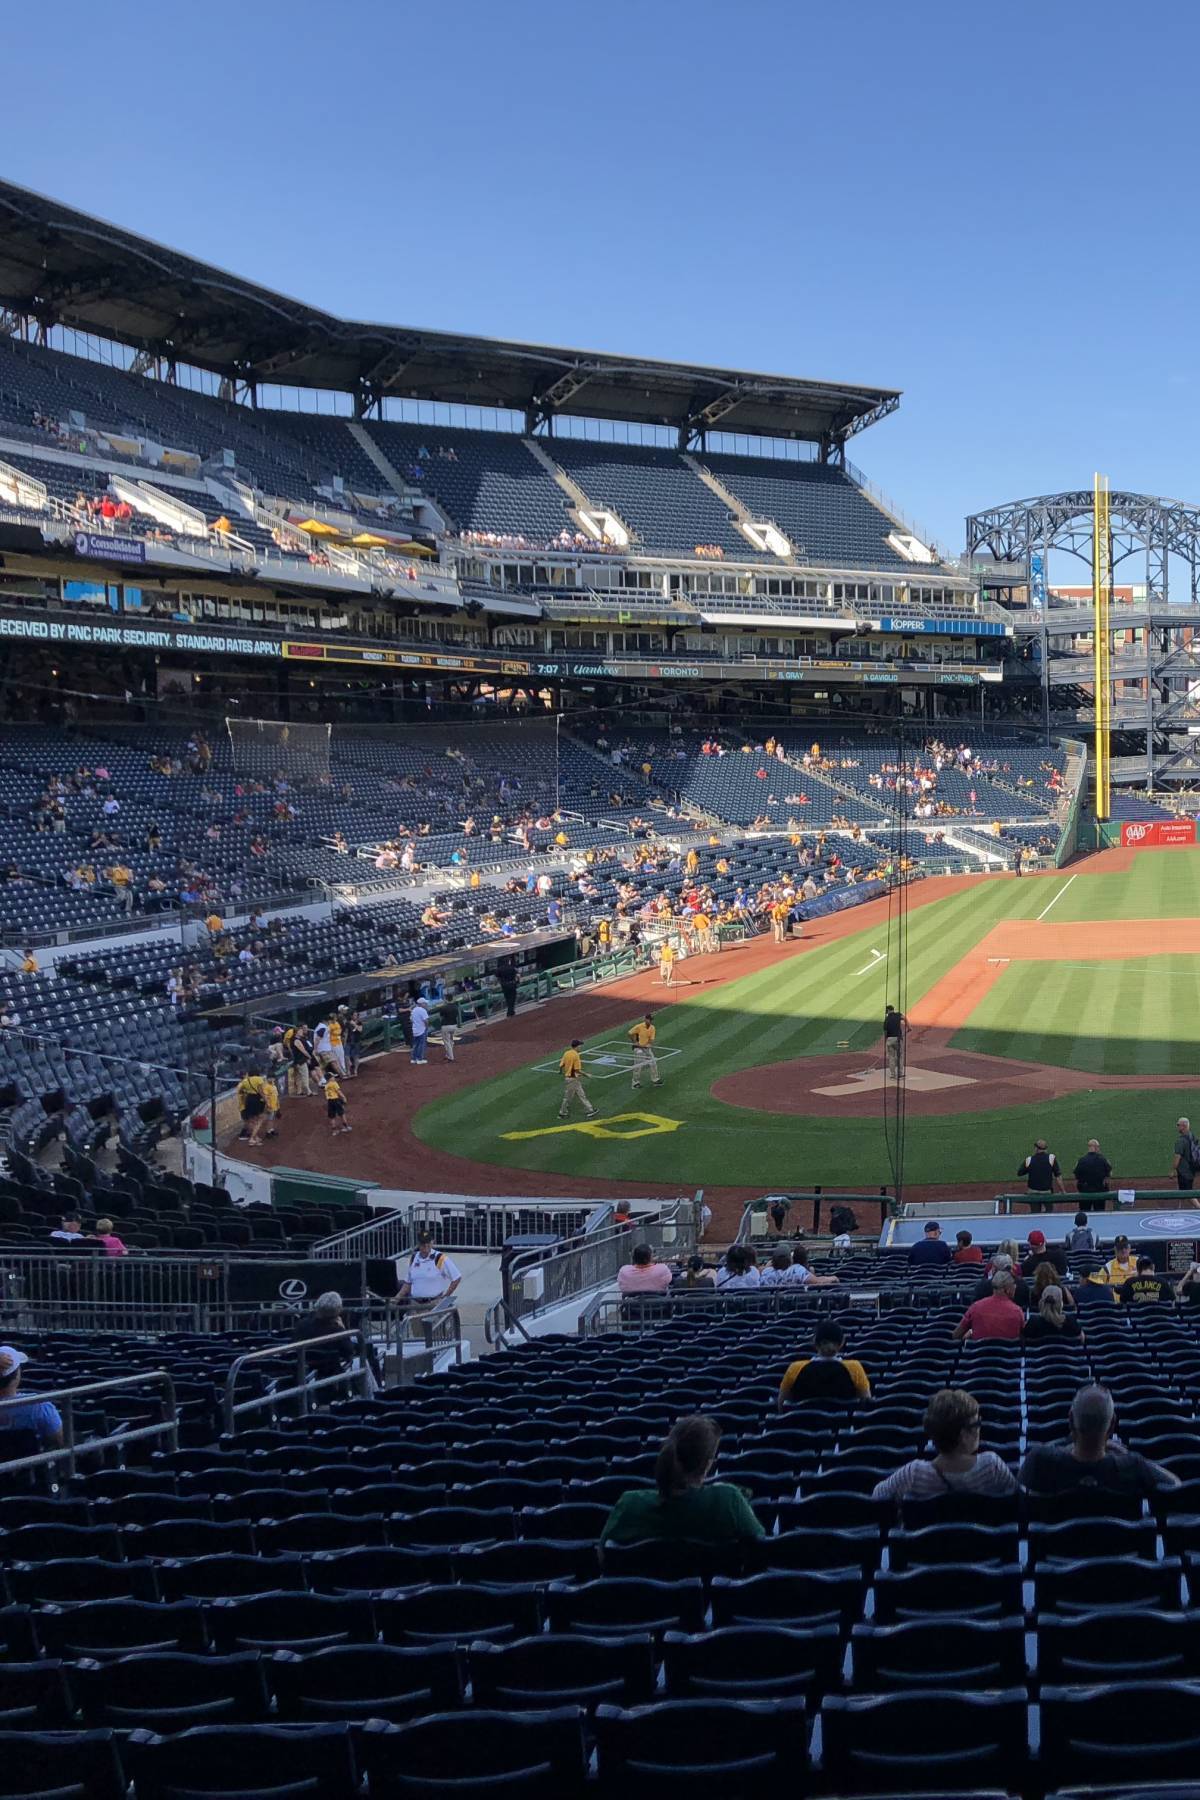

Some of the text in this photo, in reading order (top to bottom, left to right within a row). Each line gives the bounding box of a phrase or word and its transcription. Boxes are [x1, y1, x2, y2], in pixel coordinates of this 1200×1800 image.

[90, 536, 141, 553] Consolidated
[890, 618, 925, 631] KOPPERS
[0, 618, 48, 638] ECEIVED
[51, 623, 65, 638] BY
[67, 625, 91, 641] PNC
[93, 626, 122, 643] PARK
[123, 630, 173, 647] SECURITY.
[176, 636, 225, 652] STANDARD
[227, 639, 252, 653] RATES
[254, 641, 281, 655] APPLY.
[537, 664, 559, 674] 7:07
[573, 665, 619, 676] Yankees
[659, 667, 699, 676] TORONTO
[1127, 825, 1144, 839] AAA
[203, 1268, 213, 1277] 14
[1132, 1281, 1161, 1292] POLANCO
